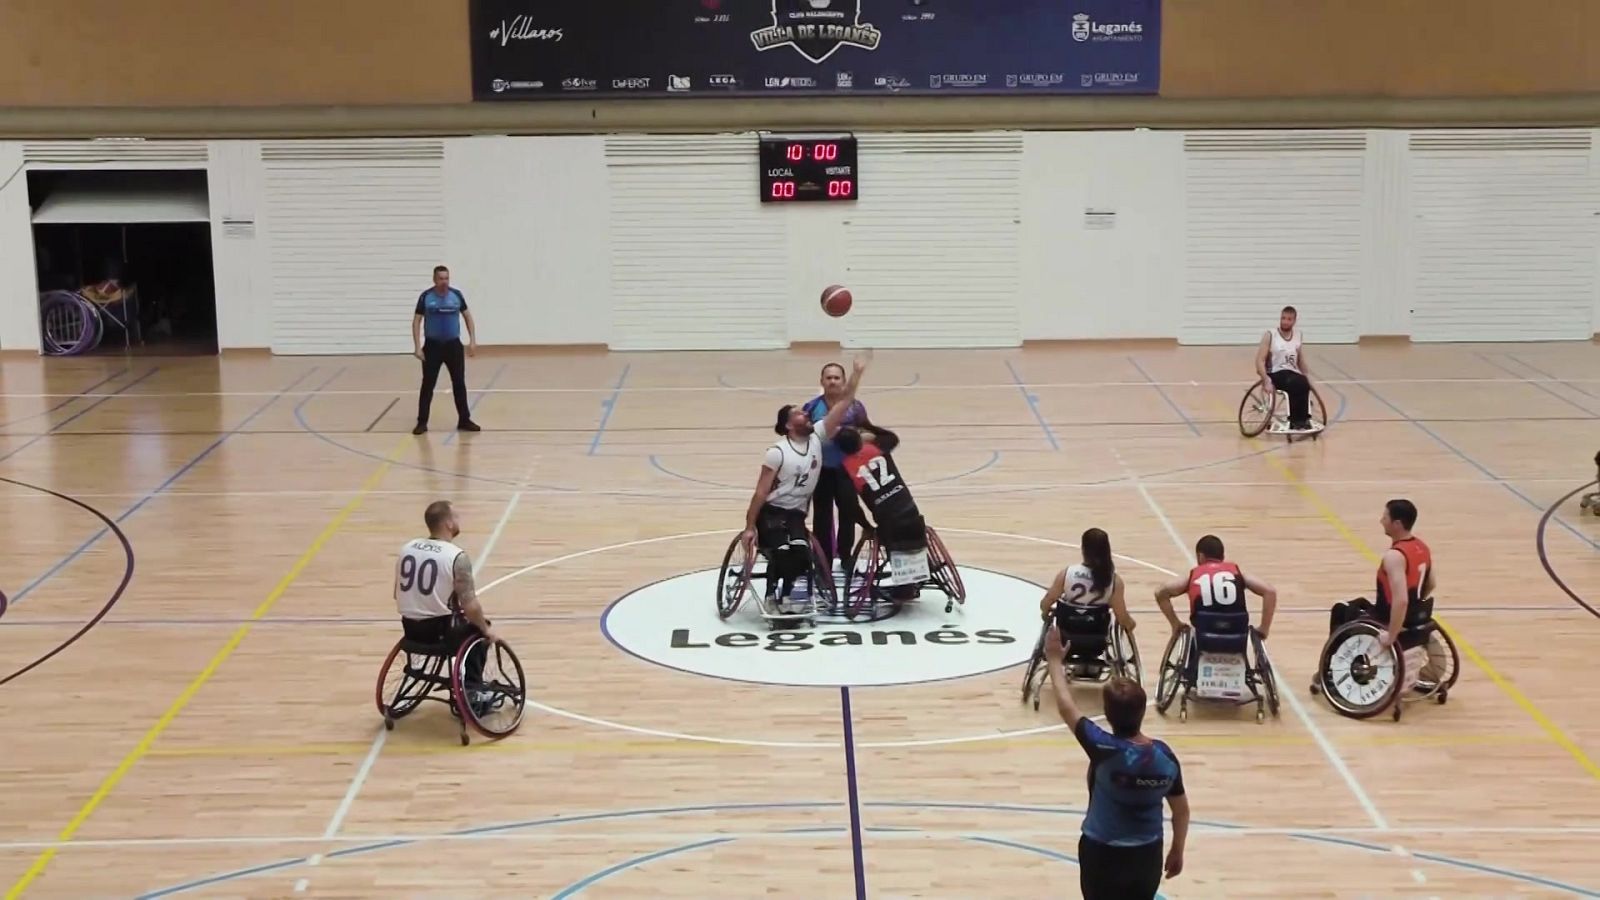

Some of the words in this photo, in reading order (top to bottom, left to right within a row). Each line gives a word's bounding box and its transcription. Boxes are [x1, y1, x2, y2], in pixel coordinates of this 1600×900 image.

[490, 14, 563, 46] #Villanos
[754, 26, 795, 47] VILLA
[797, 24, 816, 39] DE
[1092, 21, 1142, 35] Leganés
[786, 144, 837, 160] 10:00
[768, 168, 794, 177] LOCAL
[772, 182, 795, 197] 00
[828, 181, 851, 196] 00
[793, 472, 809, 487] 12
[856, 456, 896, 491] 12
[400, 554, 438, 596] 90
[1192, 571, 1237, 607] 16
[670, 624, 1016, 652] Leganés
